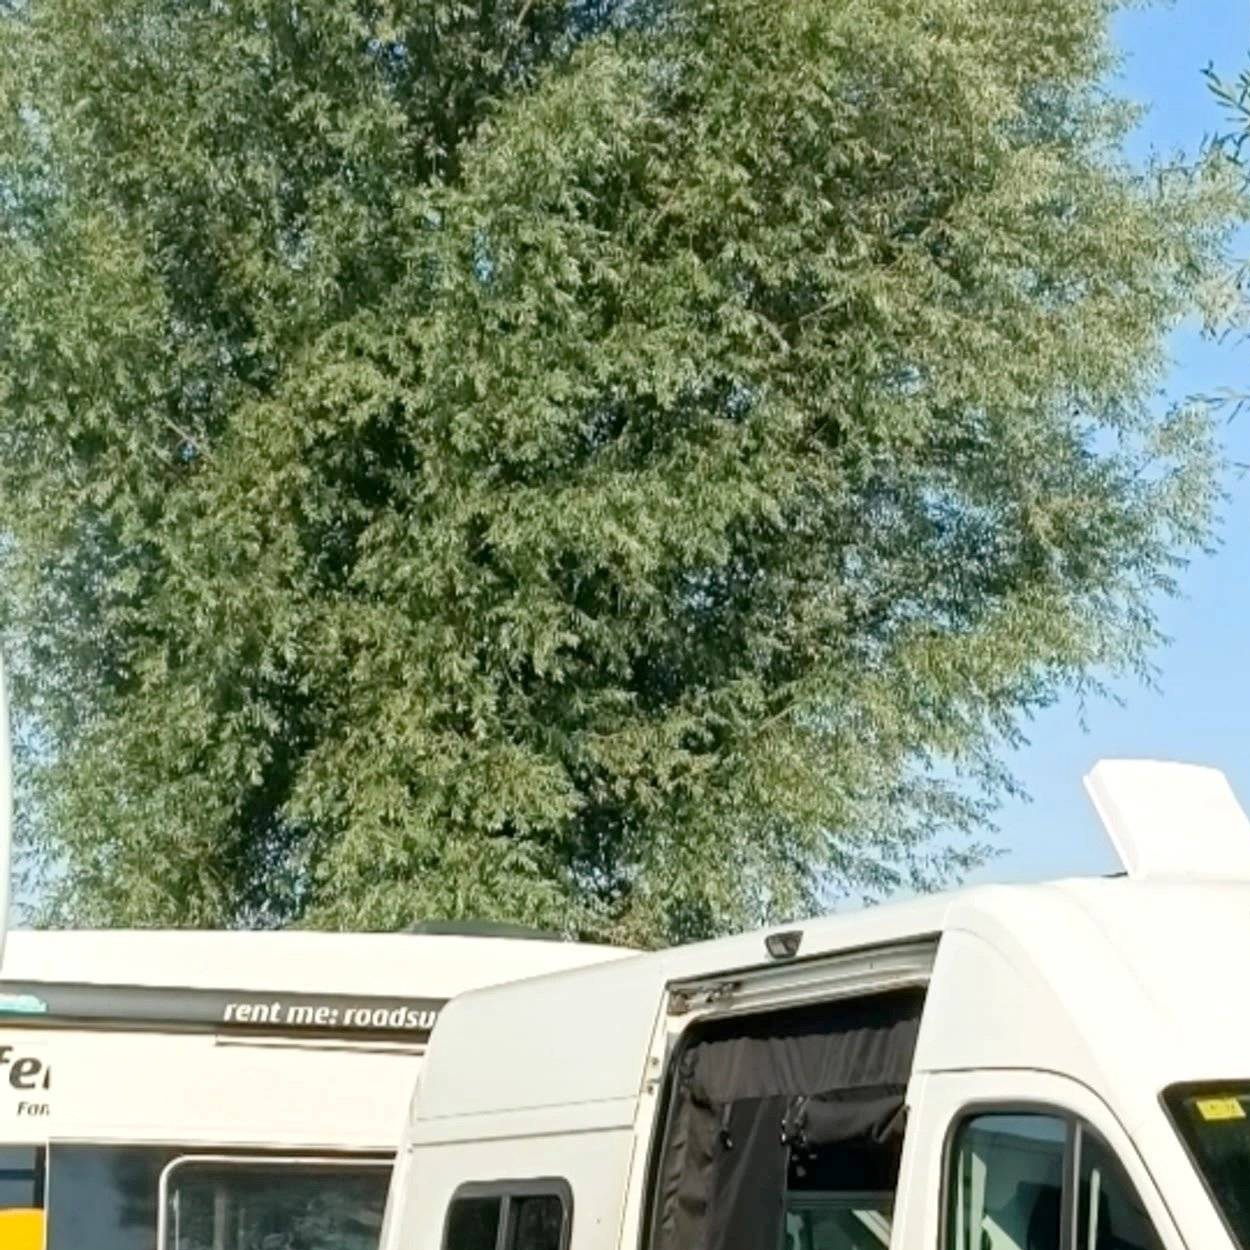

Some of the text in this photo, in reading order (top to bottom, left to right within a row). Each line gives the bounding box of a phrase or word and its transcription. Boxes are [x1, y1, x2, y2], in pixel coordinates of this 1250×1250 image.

[223, 1002, 436, 1028] rent me: roadsu
